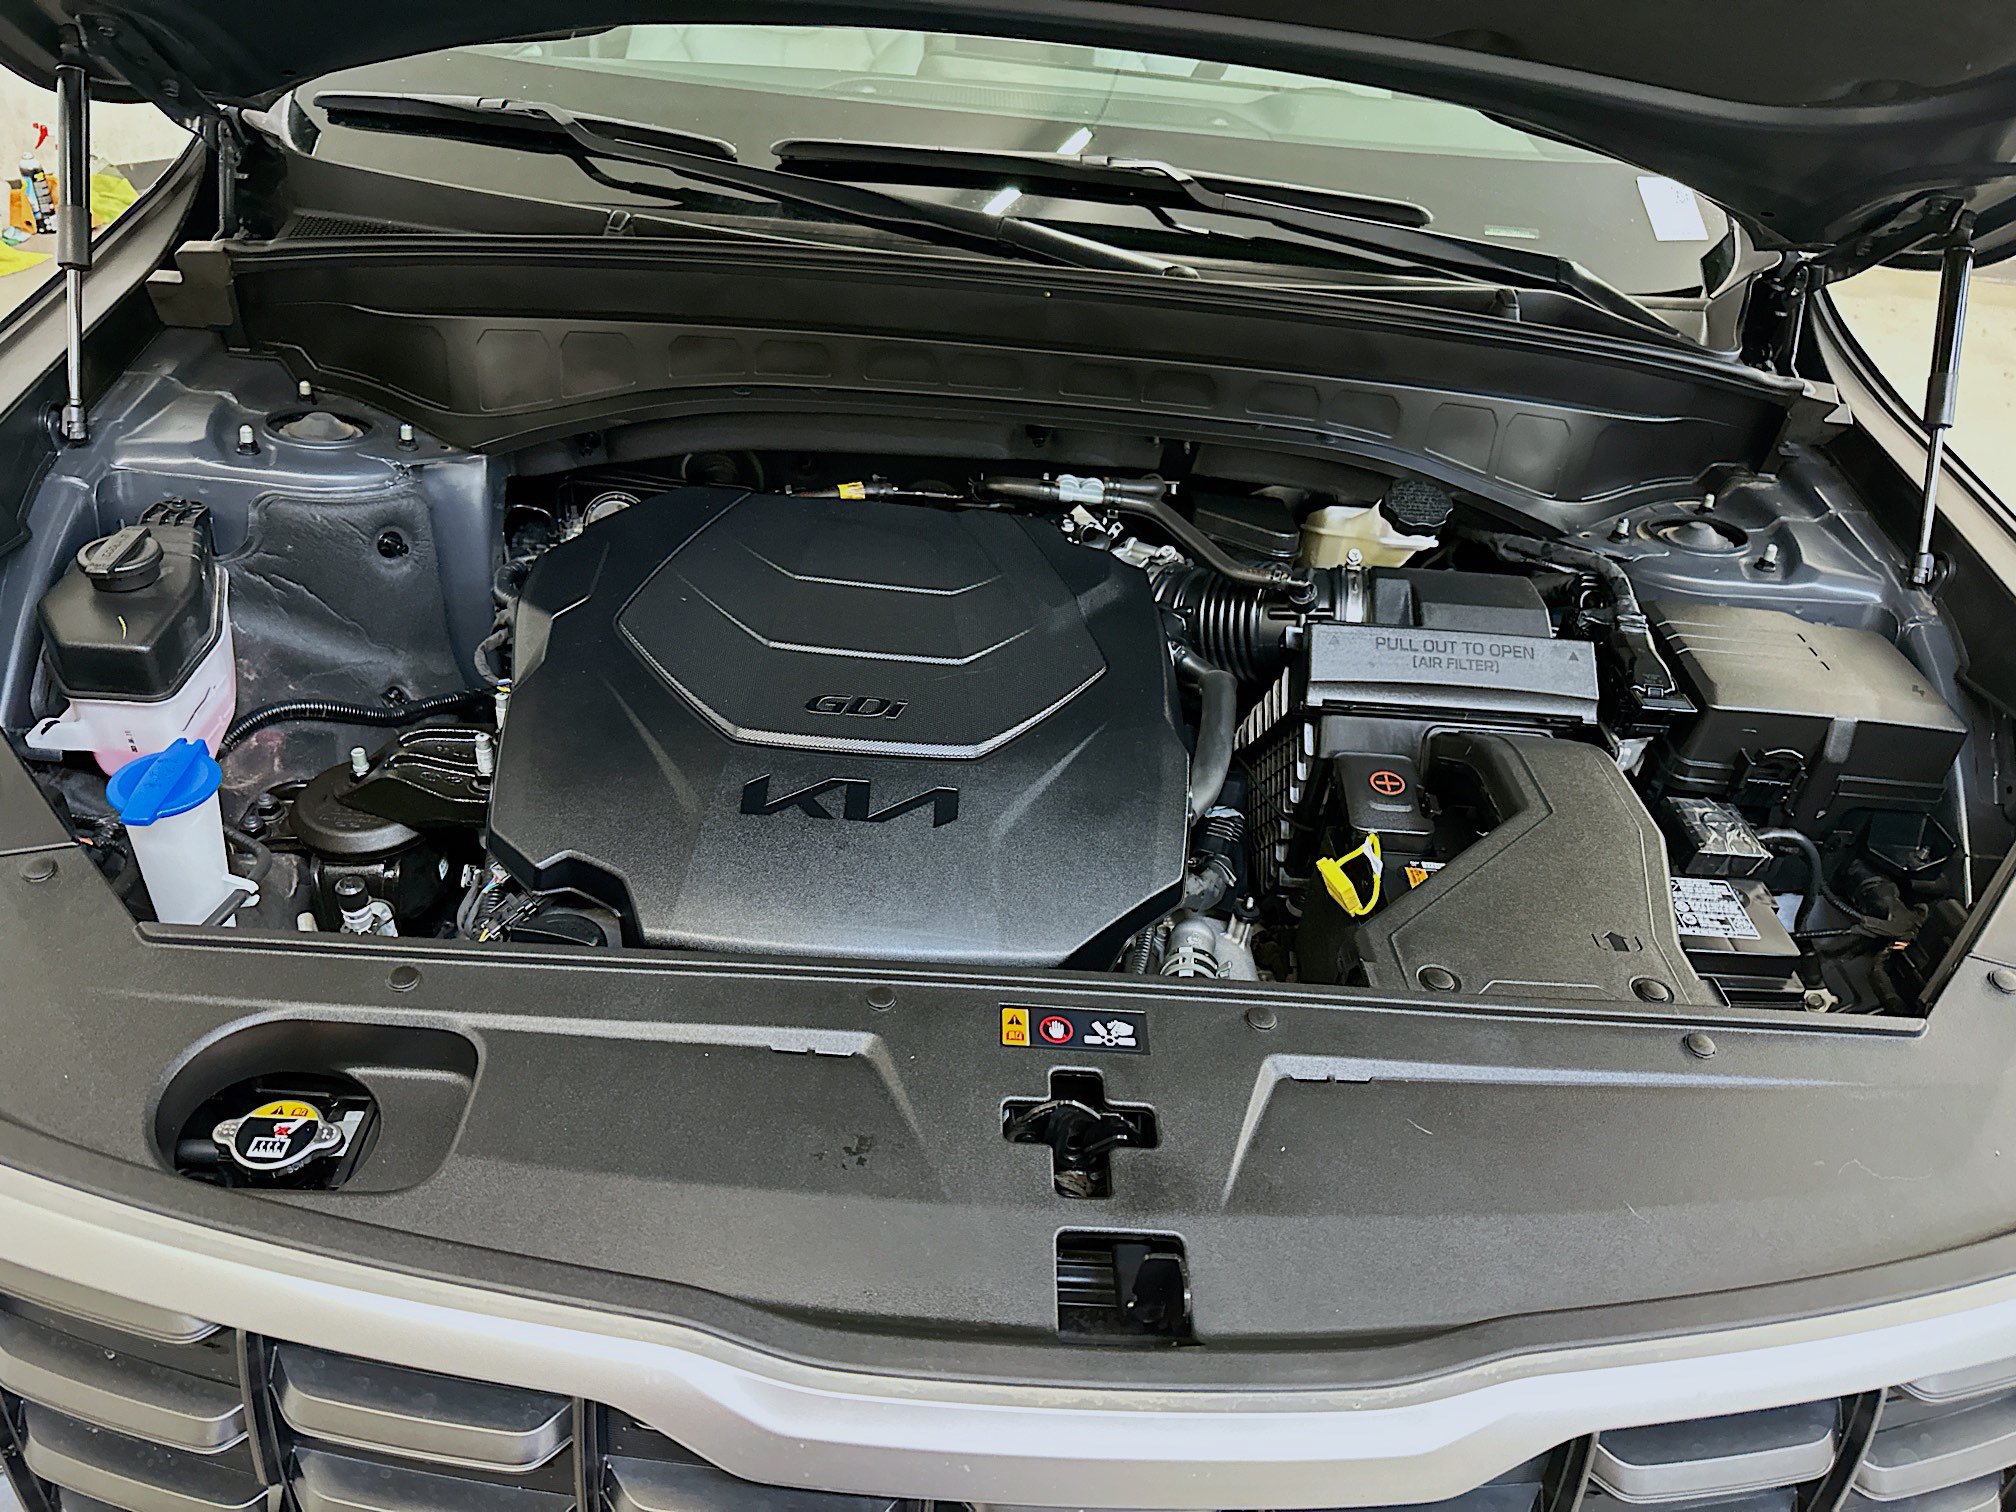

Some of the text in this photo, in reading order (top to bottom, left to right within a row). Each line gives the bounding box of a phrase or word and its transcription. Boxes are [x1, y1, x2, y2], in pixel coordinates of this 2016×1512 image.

[1375, 636, 1535, 659] PULL OUT TO OPEN
[804, 694, 910, 720] GDi
[740, 773, 959, 829] KIA
